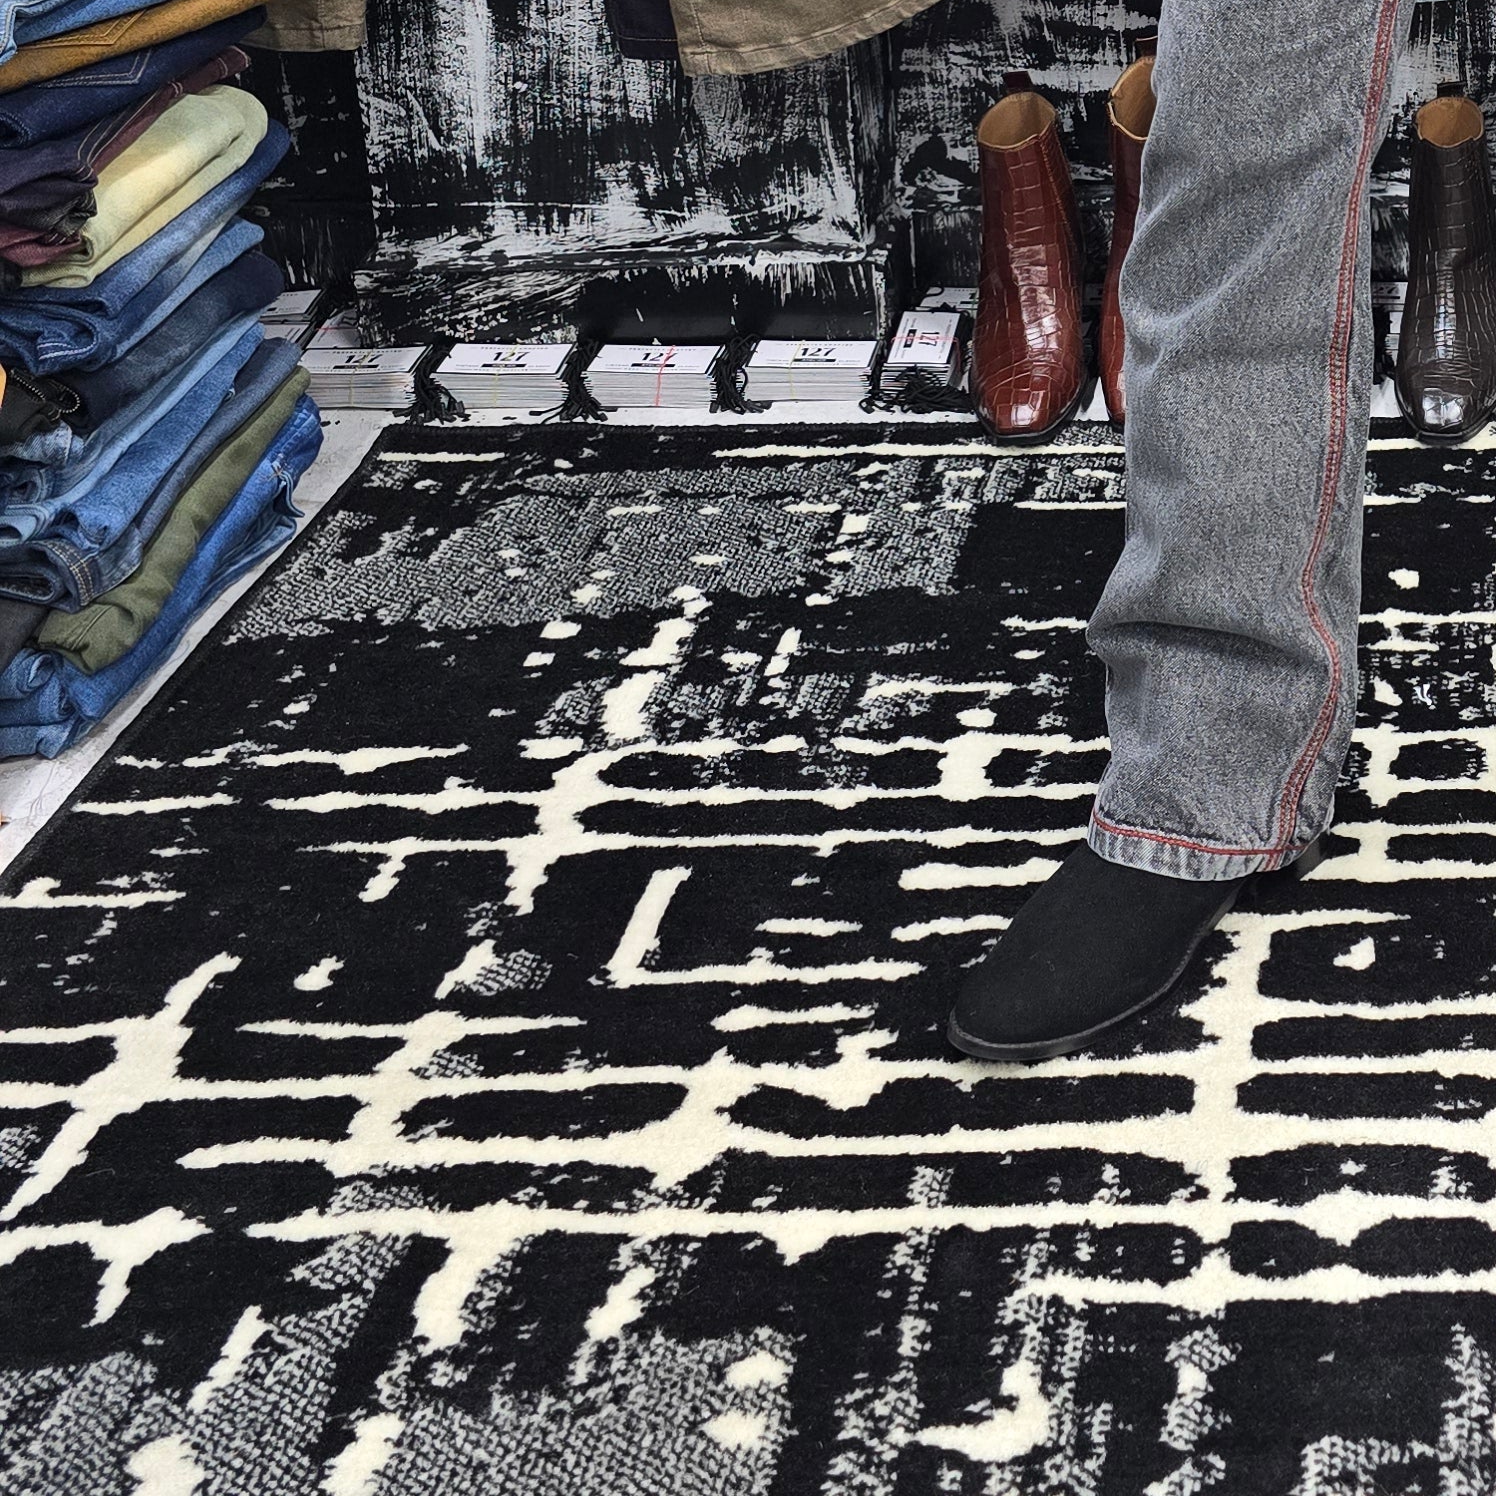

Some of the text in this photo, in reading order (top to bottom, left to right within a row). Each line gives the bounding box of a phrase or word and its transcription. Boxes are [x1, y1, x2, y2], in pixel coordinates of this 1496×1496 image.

[918, 331, 940, 347] 127
[493, 351, 530, 361] 127
[642, 352, 678, 362] 127
[801, 347, 837, 357] 127
[345, 354, 383, 364] 127
